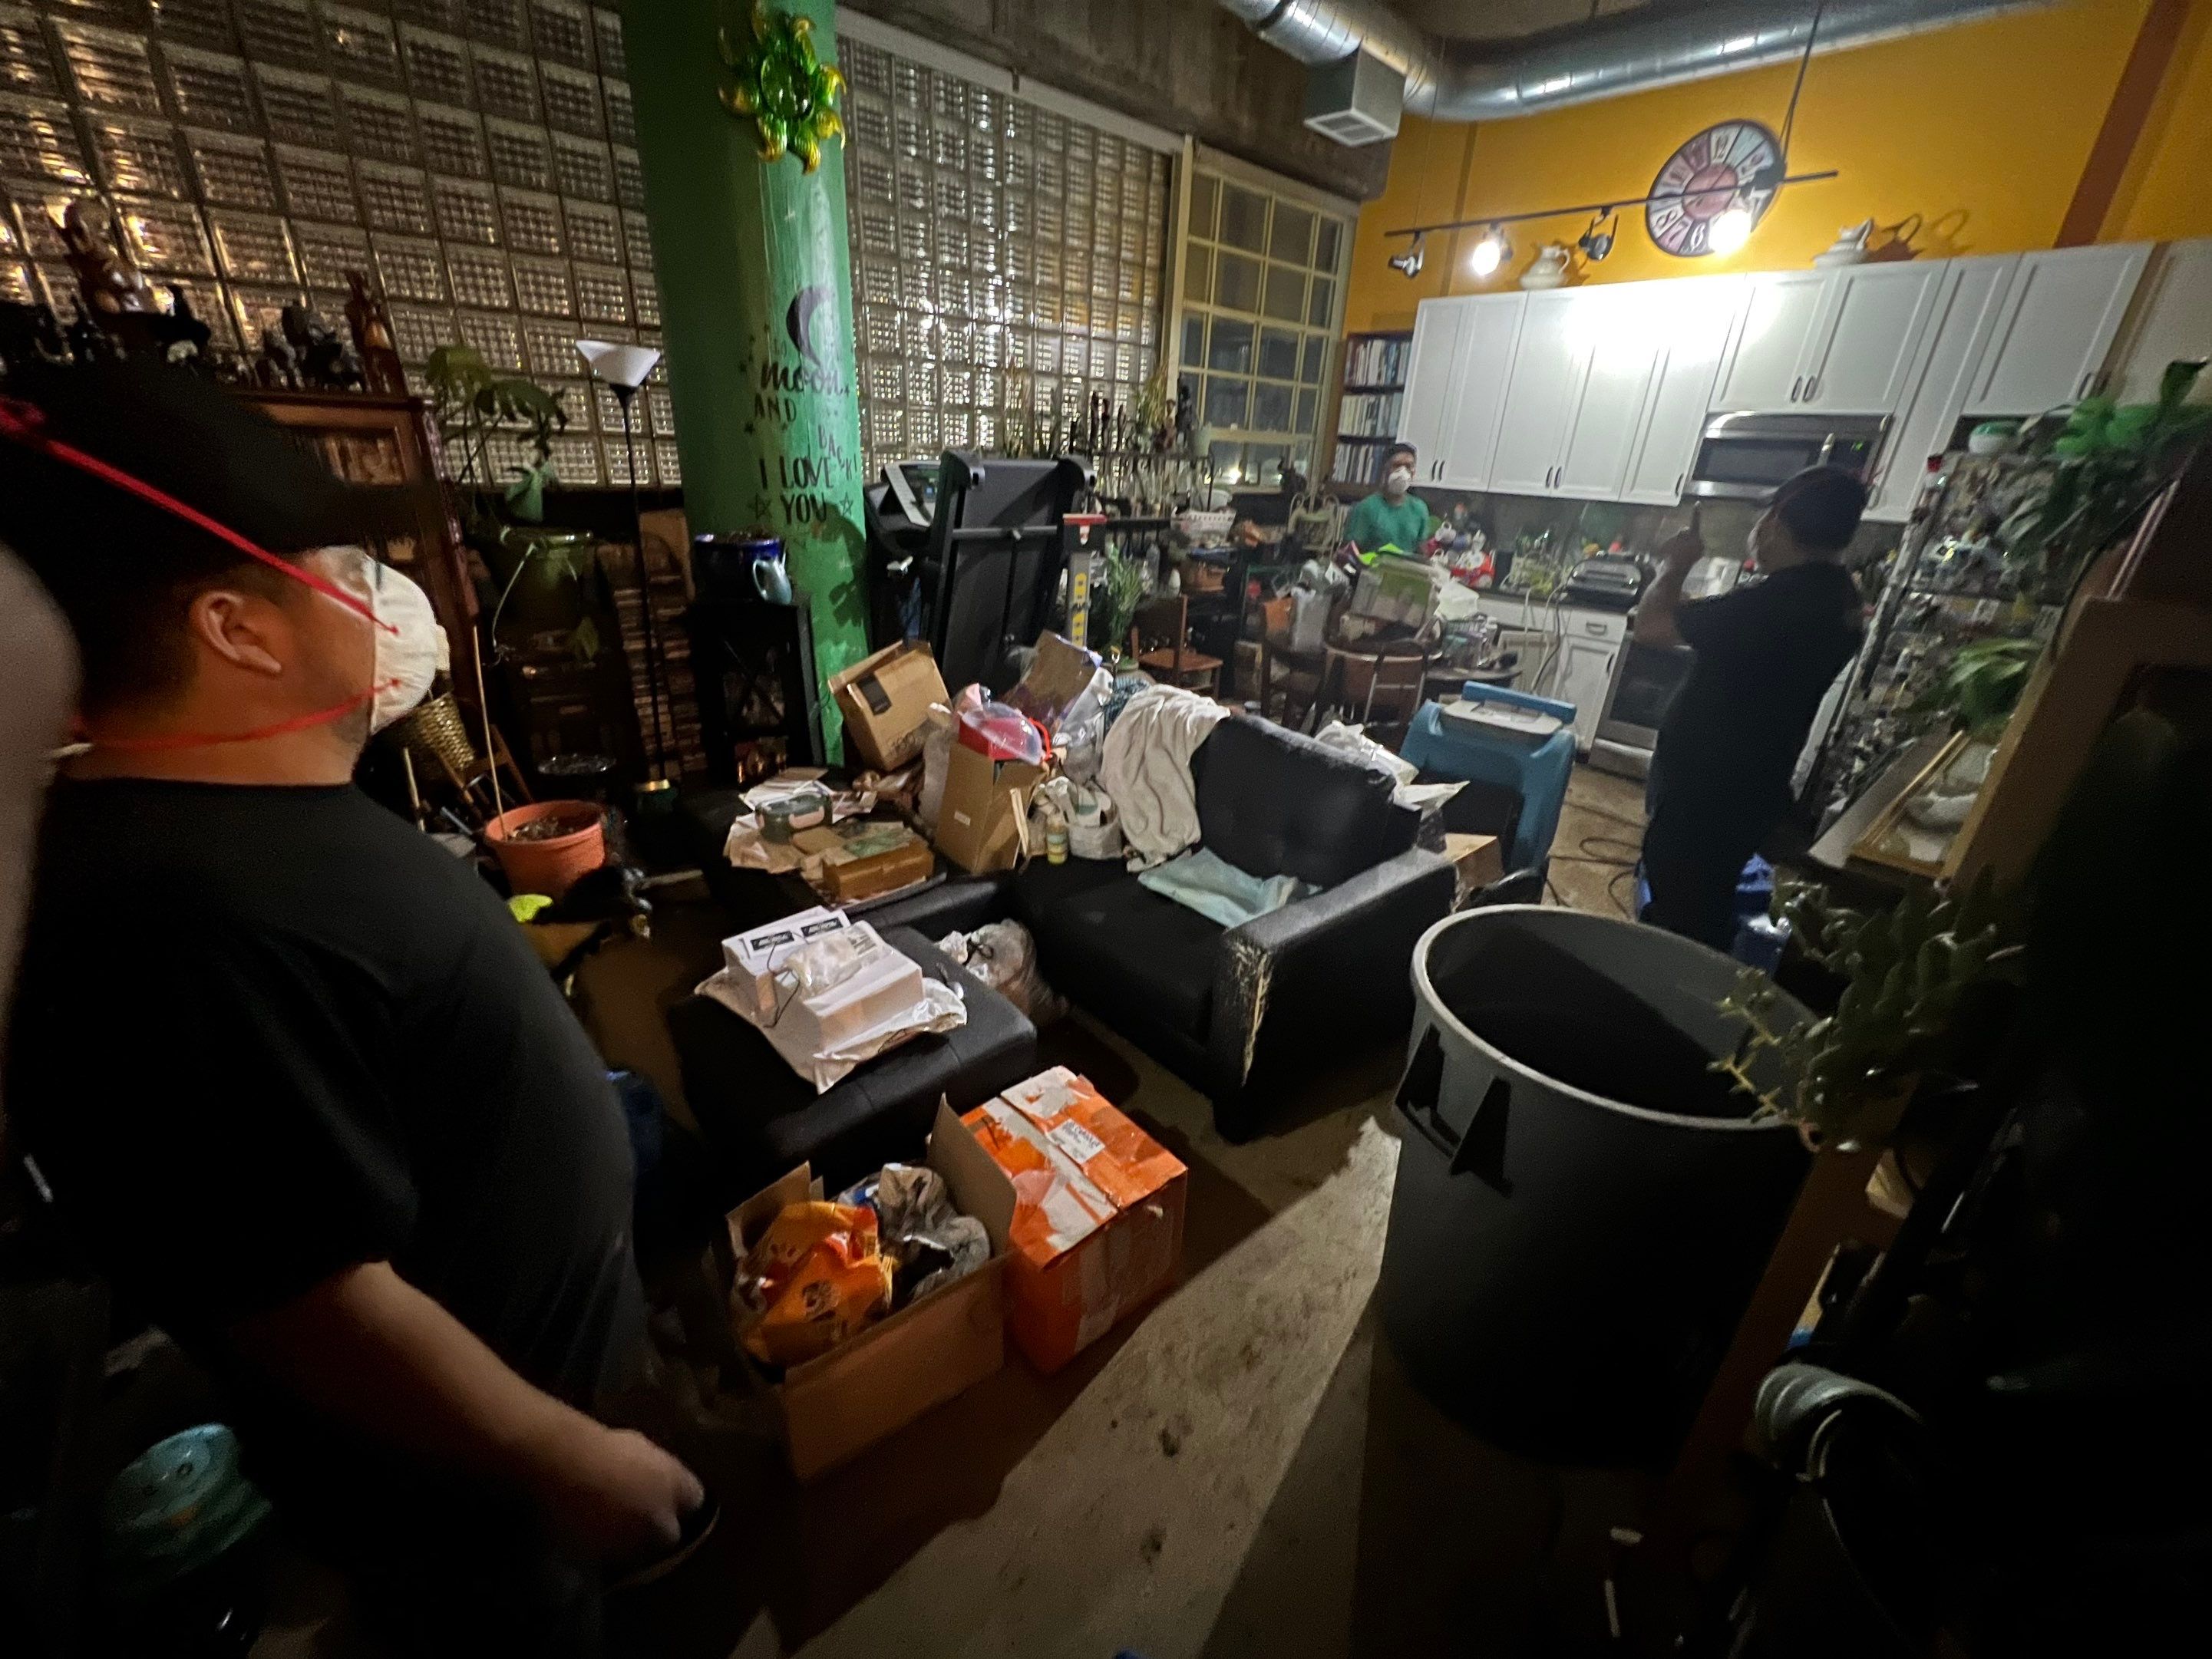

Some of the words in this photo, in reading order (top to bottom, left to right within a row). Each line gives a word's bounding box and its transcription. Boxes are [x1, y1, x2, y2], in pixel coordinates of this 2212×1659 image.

[1691, 224, 1705, 249] 6
[754, 392, 797, 423] AND
[758, 457, 768, 490] I
[779, 455, 834, 490] LOVE
[779, 492, 827, 526] YOU
